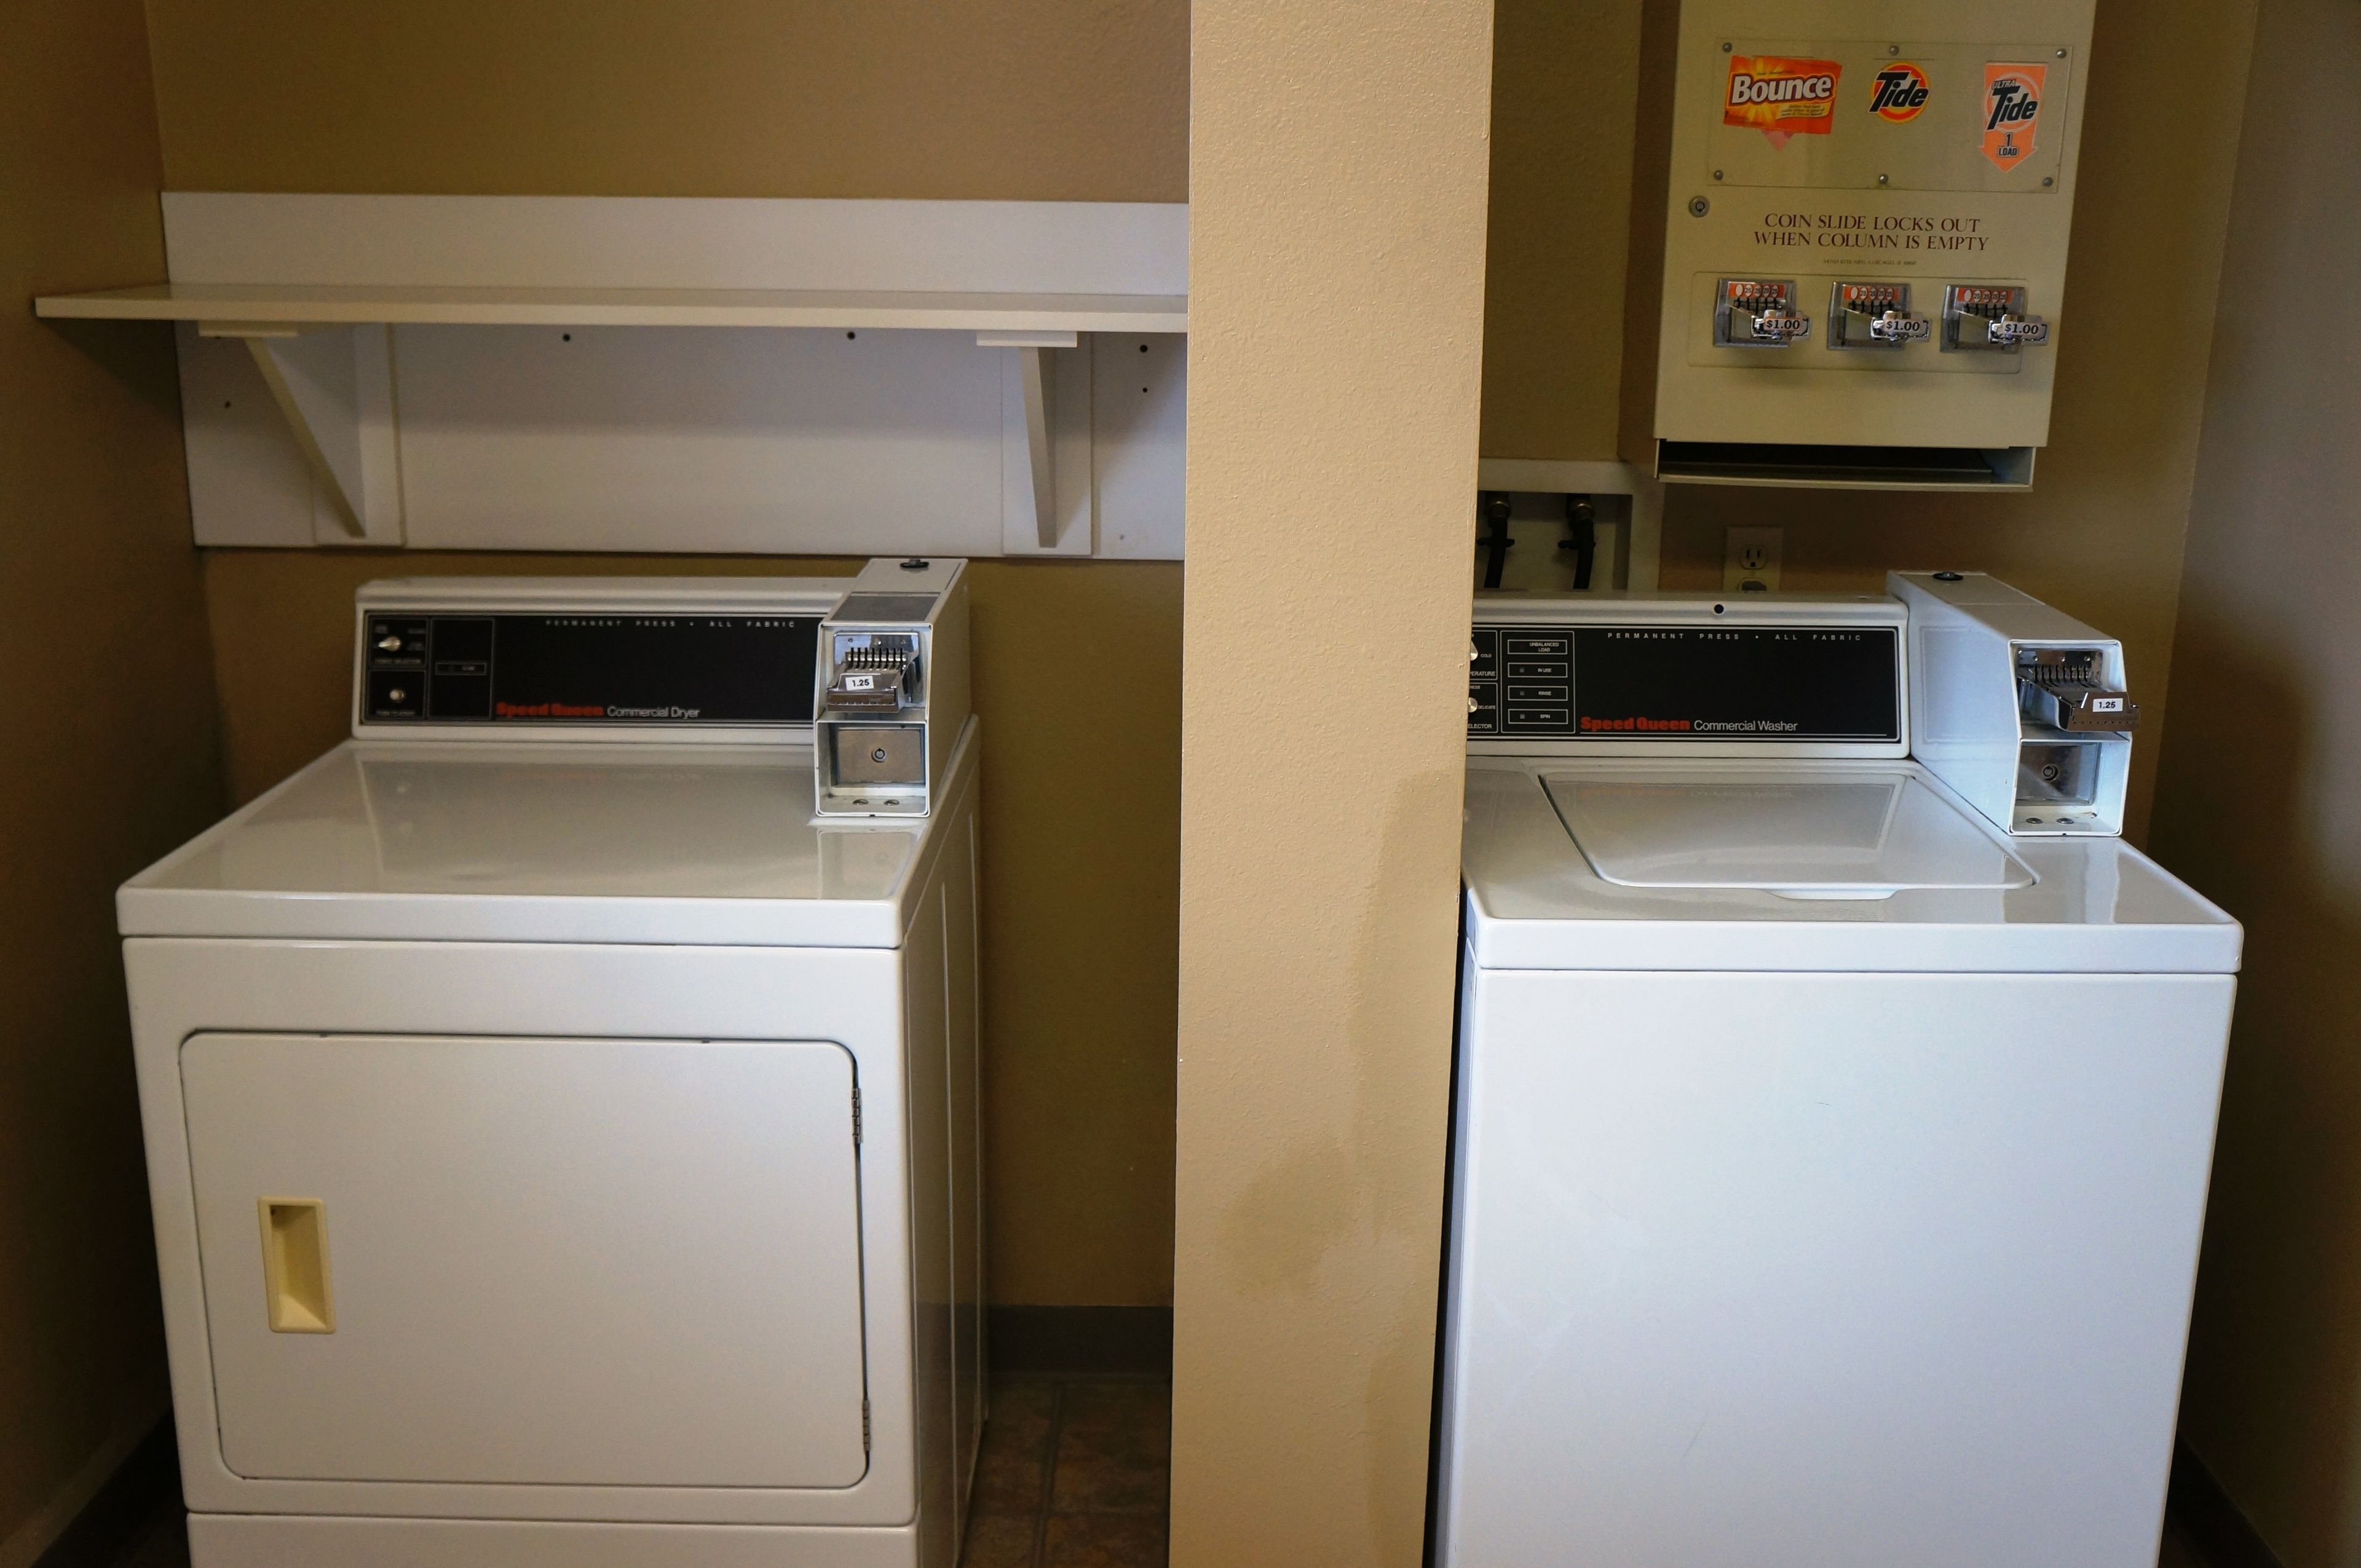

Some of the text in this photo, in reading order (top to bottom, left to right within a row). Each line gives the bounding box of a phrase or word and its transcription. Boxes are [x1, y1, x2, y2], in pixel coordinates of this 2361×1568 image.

[1731, 75, 1832, 104] Bounce
[1992, 79, 2017, 89] ULTRA
[1869, 71, 1929, 112] Tide
[1986, 85, 2038, 130] Tide
[2005, 133, 2013, 147] 1
[1998, 147, 2018, 157] LOAD
[1765, 213, 1981, 233] COIN SLIDE LOCKS OUT
[1754, 231, 1990, 251] WHEN COLUMN IS EMPTY
[1766, 319, 1801, 330] $1.00
[1886, 321, 1920, 331] $1.00
[2004, 323, 2039, 334] $1.00
[852, 679, 870, 687] 1.25
[496, 701, 700, 720] Speed Queen Commercial Dryer
[1580, 717, 1798, 732] Speed Queen Commercial Washer
